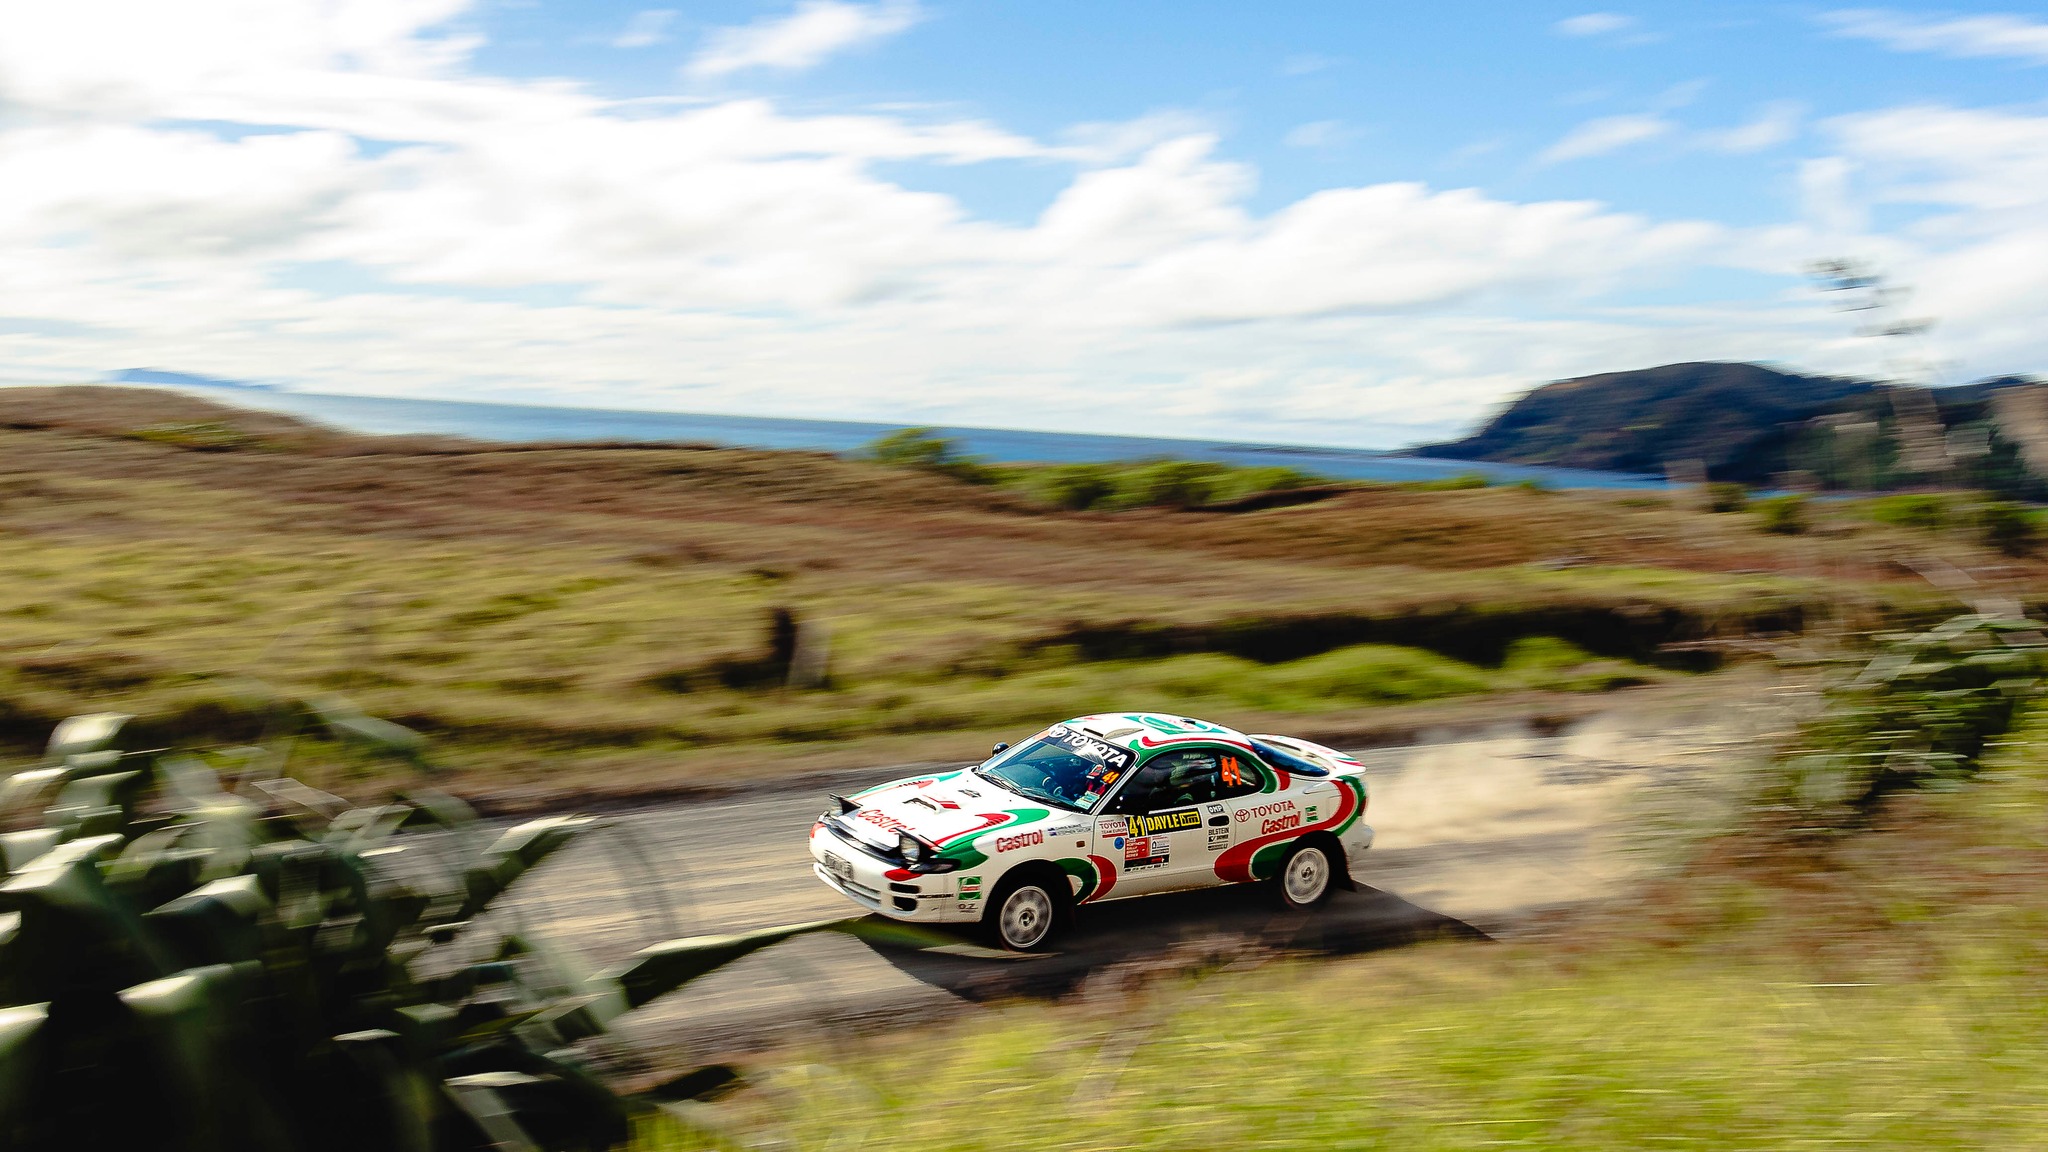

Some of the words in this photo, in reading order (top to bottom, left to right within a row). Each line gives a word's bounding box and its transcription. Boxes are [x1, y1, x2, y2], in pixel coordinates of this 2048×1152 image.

[1062, 731, 1128, 768] TOYOTA
[1102, 771, 1120, 784] 41
[1221, 756, 1242, 786] 41
[1208, 804, 1223, 813] OMP
[1251, 800, 1296, 818] TOYOTA
[1100, 821, 1127, 829] TOYOTA
[1129, 815, 1146, 837] 41
[1146, 814, 1181, 831] DAYLE
[1208, 827, 1230, 836] BILSTEIN
[1261, 811, 1302, 835] Castrol
[996, 829, 1044, 853] Castrol
